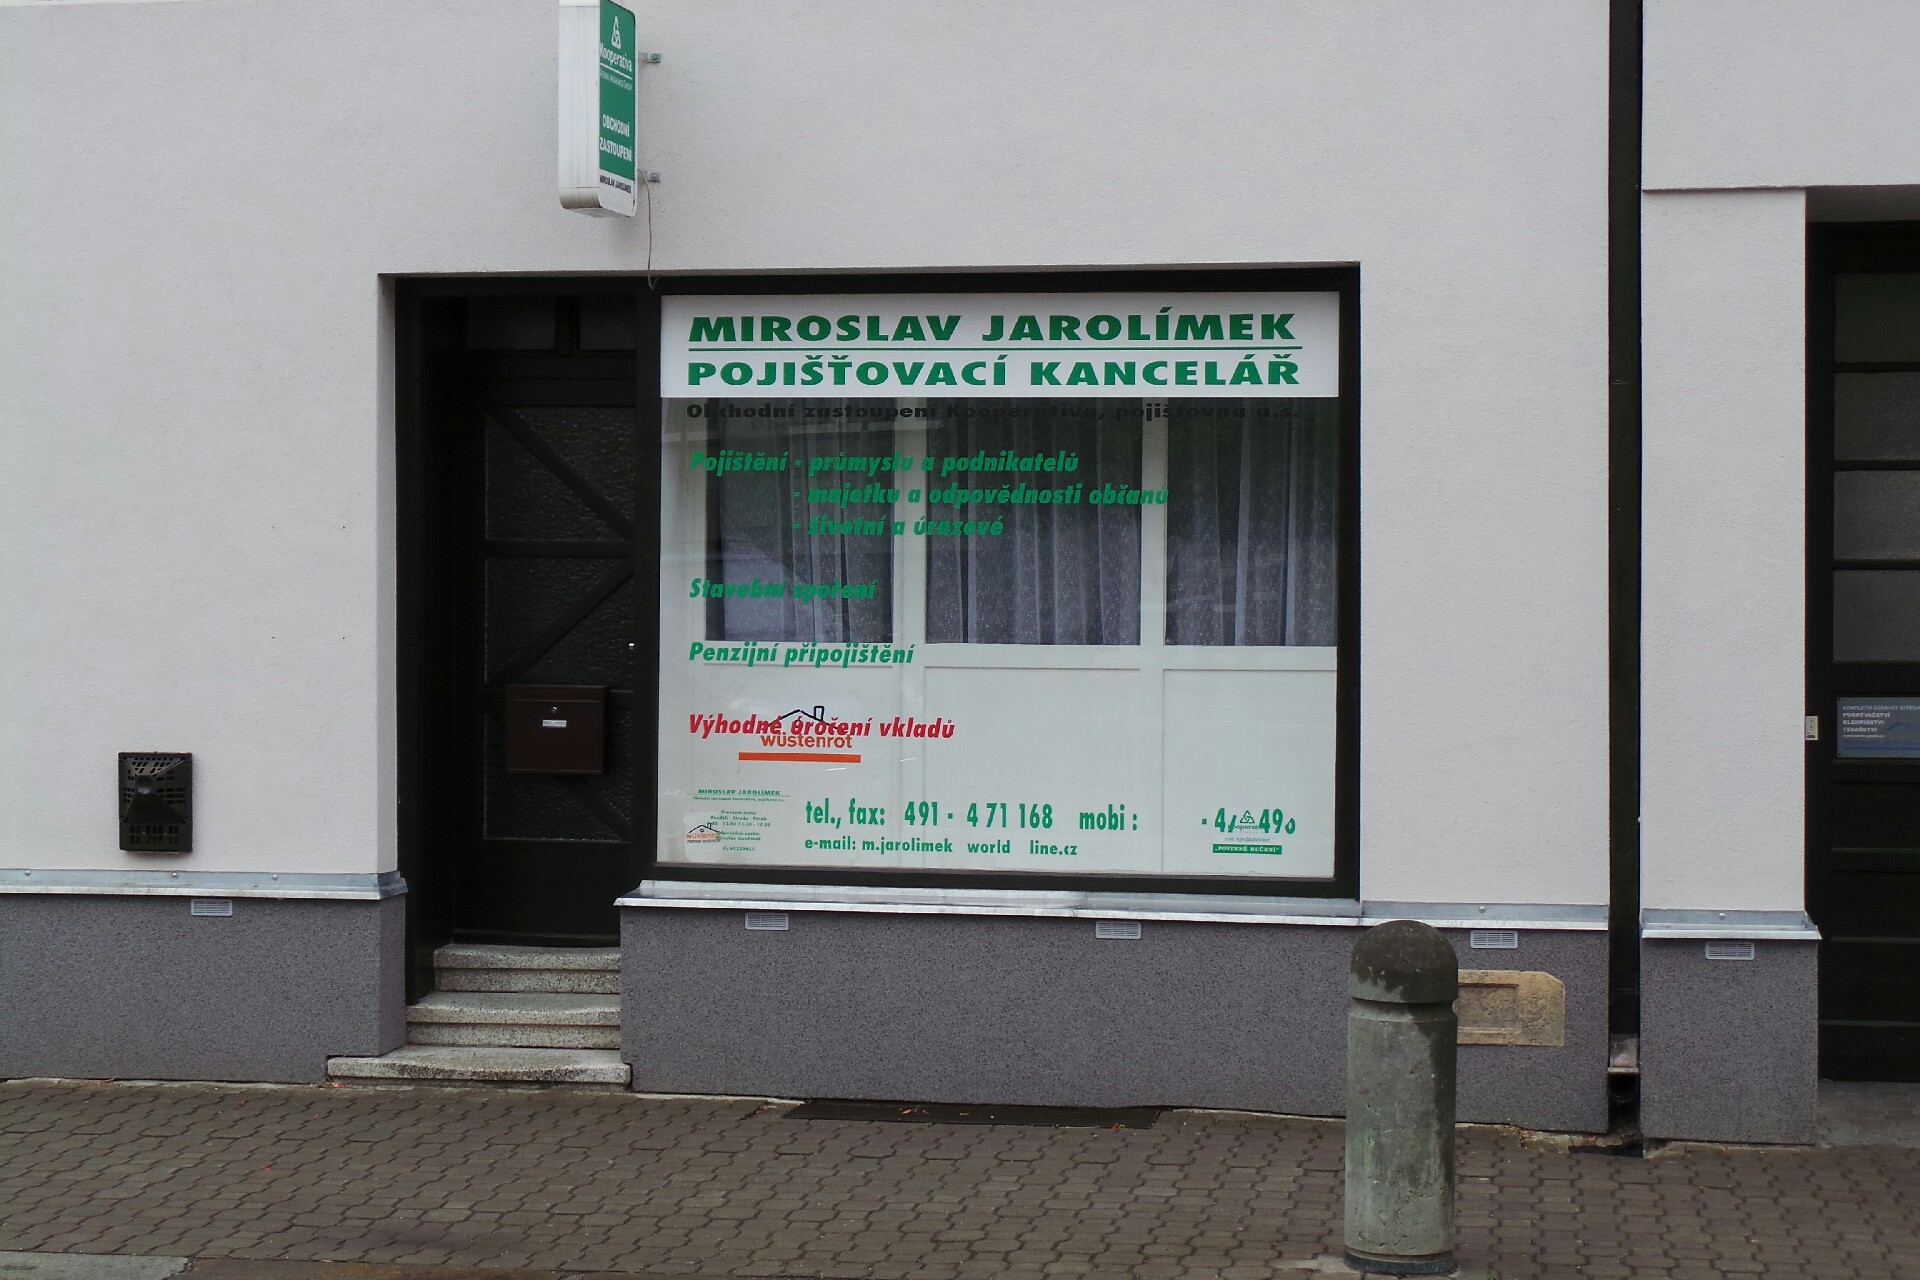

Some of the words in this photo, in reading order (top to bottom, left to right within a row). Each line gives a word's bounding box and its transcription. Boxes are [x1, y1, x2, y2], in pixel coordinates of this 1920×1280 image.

[602, 114, 630, 138] OBCHODNÍ
[600, 136, 633, 162] ZASTOUPENÍ
[688, 315, 962, 342] MIROSLAV
[982, 306, 1296, 342] JAROLÍMEK
[687, 354, 1008, 387] POJIŠŤOVACÍ
[1030, 354, 1300, 387] KANCELÁŘ
[690, 449, 788, 477] Pojištění
[808, 449, 914, 477] průmyslu
[922, 456, 935, 471] a
[941, 450, 1079, 477] podnikatelů
[807, 482, 900, 509] majetku
[908, 489, 921, 504] a
[929, 482, 1083, 509] odpovědnosti
[807, 514, 887, 536] životní
[892, 521, 905, 535] a
[913, 515, 1005, 536] úrazové
[689, 578, 786, 599] Stavební
[792, 579, 878, 605] spoření
[689, 641, 779, 668] Penzijní
[784, 641, 916, 669] připojištění
[689, 713, 783, 739] Výhodné
[790, 716, 873, 737] úročení
[879, 717, 955, 739] vkladů
[759, 732, 853, 749] wüstenrot
[805, 797, 841, 830] tel.,
[848, 797, 885, 826] fax:
[904, 800, 938, 826] 491
[1018, 802, 1053, 829] 168
[804, 835, 856, 850] e-mail:
[862, 836, 953, 855] m.jarolimek
[967, 839, 1011, 854] world
[1029, 839, 1078, 856] line.cz
